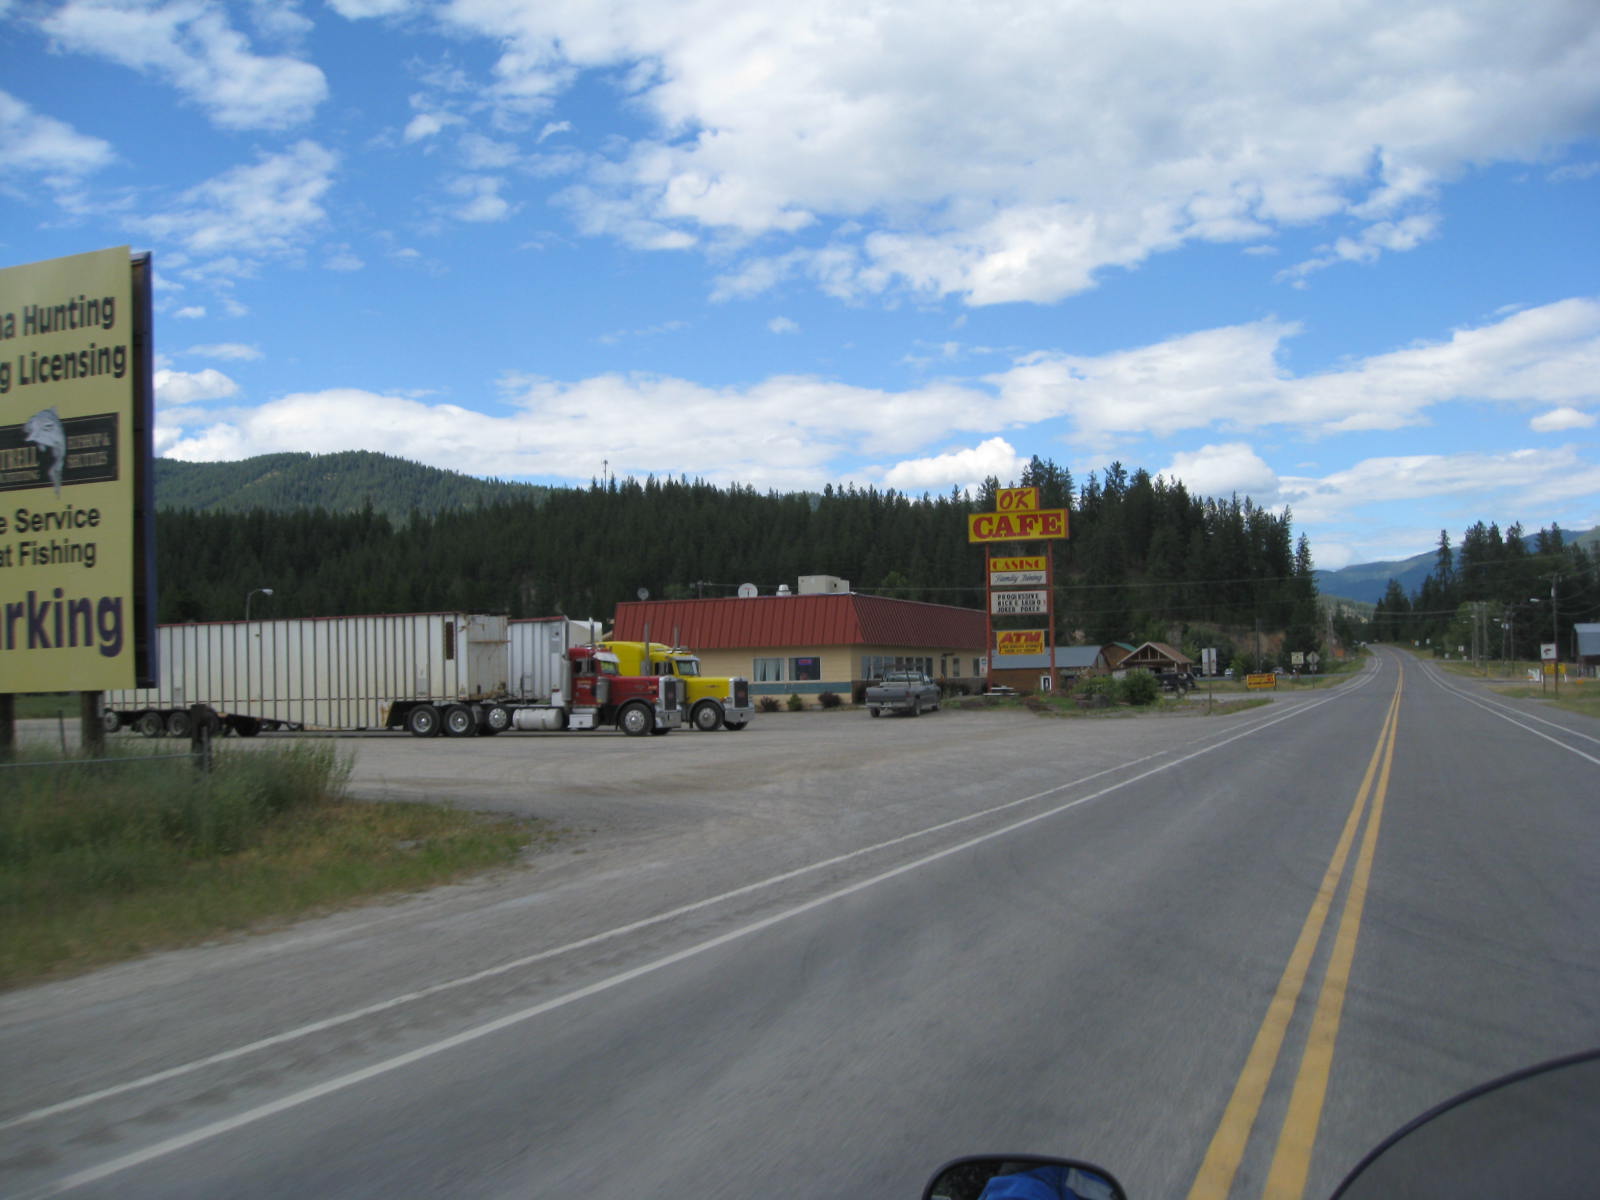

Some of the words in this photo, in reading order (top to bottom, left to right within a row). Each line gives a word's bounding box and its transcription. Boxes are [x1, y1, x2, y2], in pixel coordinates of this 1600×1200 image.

[23, 294, 115, 336] Hunting
[18, 342, 126, 385] Licensing
[999, 490, 1032, 510] OK
[15, 504, 100, 533] Service
[973, 512, 1062, 539] CAFE
[19, 538, 96, 568] Fishing
[991, 559, 1042, 570] CASINO
[0, 587, 124, 658] rking
[1000, 632, 1042, 644] ATM
